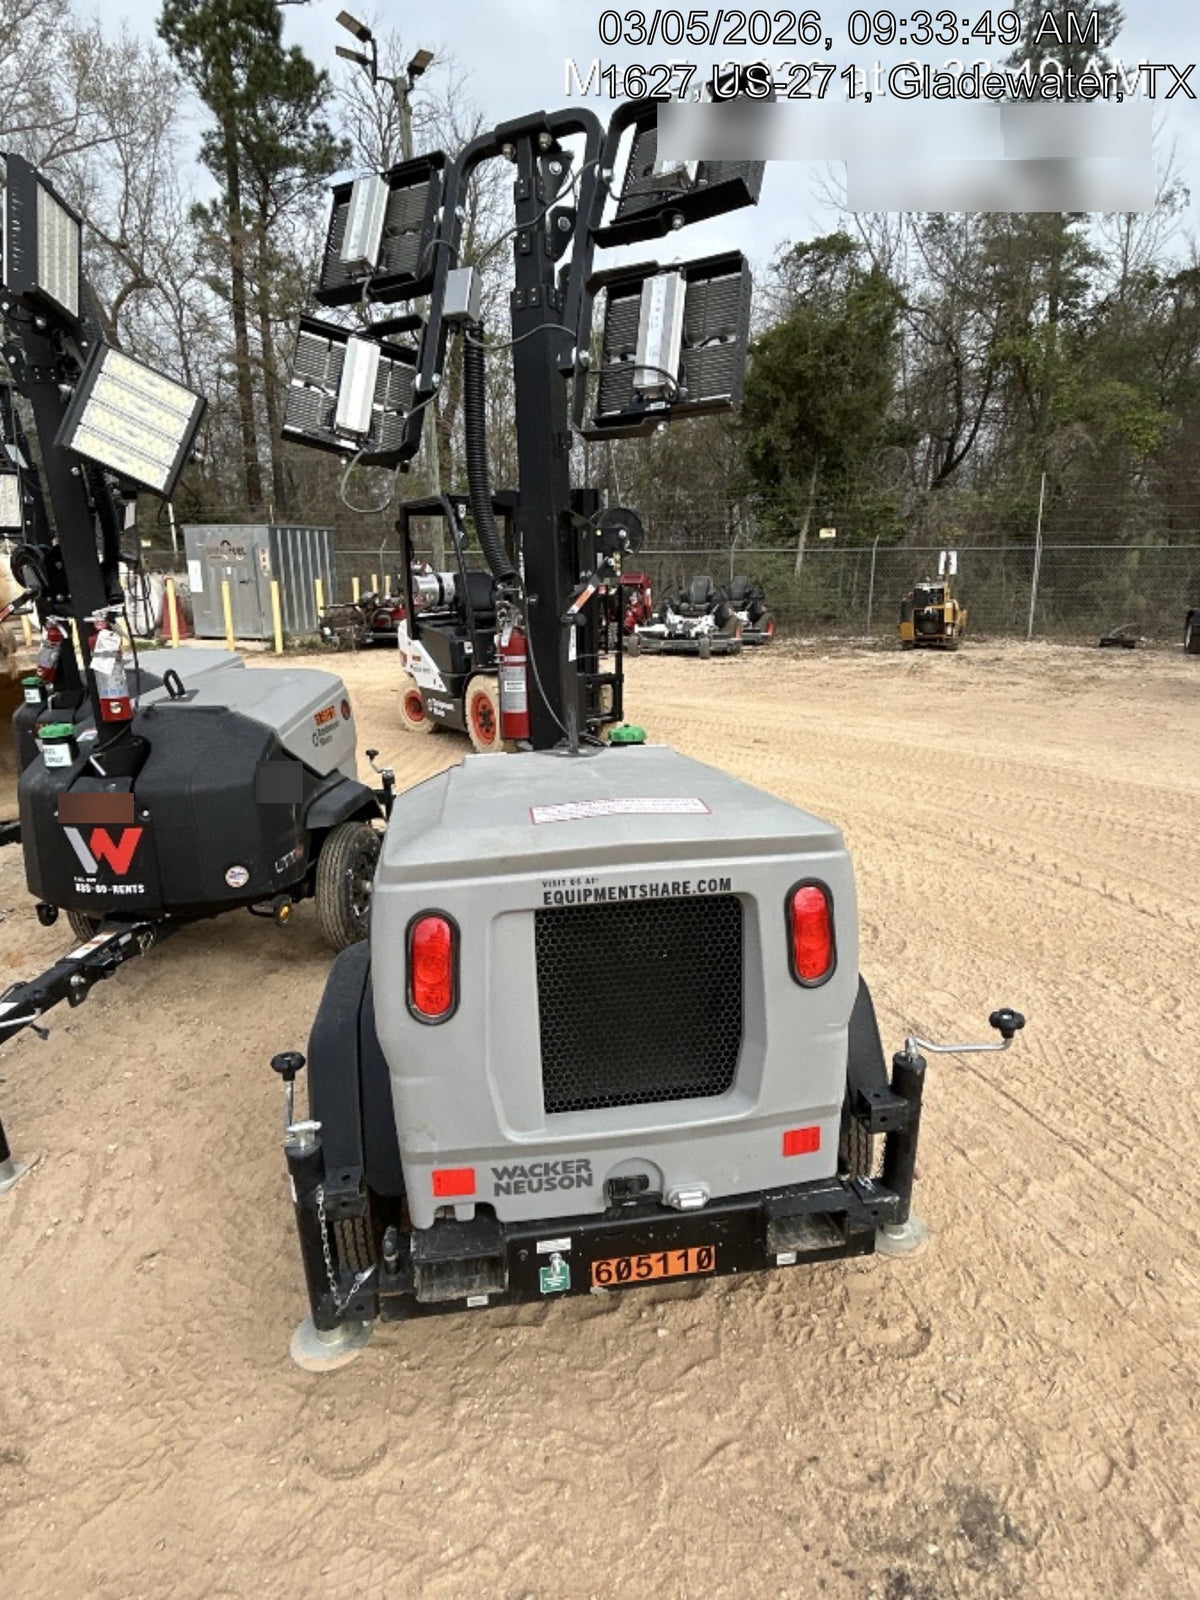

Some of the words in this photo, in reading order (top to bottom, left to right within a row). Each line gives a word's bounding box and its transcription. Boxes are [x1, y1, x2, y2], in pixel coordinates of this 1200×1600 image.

[543, 878, 732, 906] EQUIPMENTSHARE.COM
[491, 1158, 593, 1182] WACKER
[493, 1172, 594, 1198] NEUSON
[594, 1246, 713, 1285] 605110
